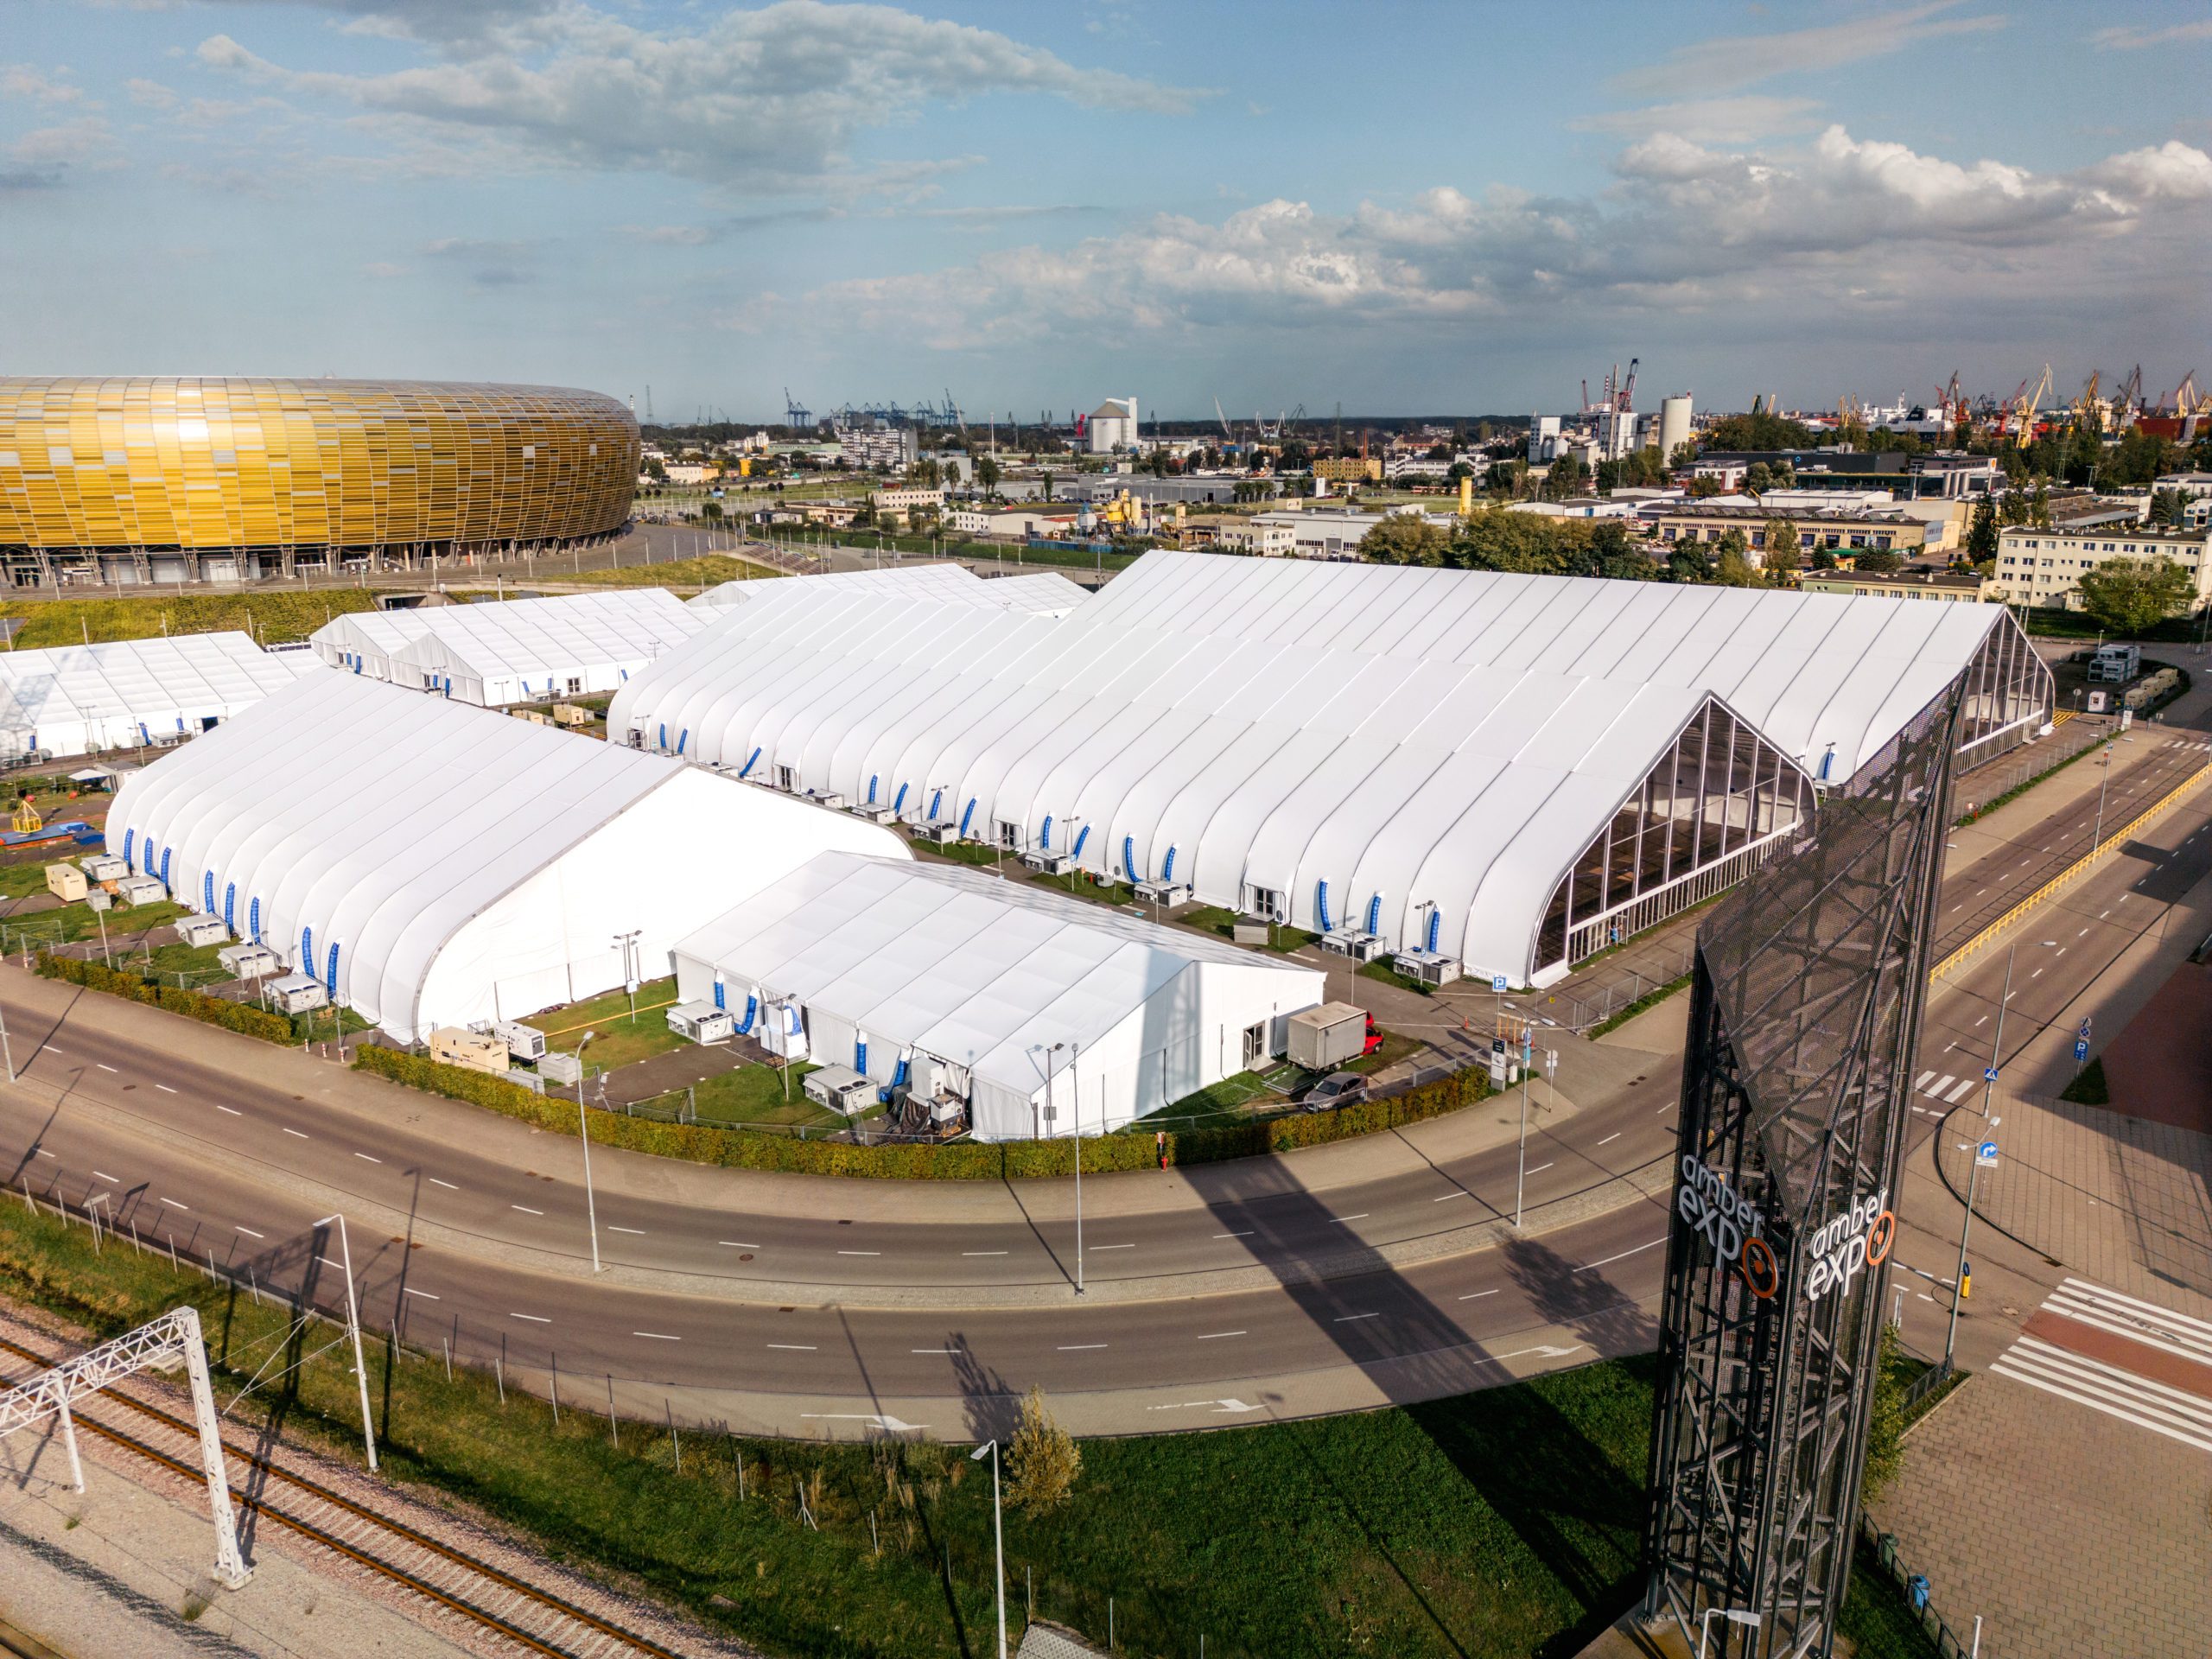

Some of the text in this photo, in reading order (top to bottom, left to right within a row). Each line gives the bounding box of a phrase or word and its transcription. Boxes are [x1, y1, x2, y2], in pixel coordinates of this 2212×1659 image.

[1496, 977, 1503, 988] P
[1682, 1155, 1764, 1237] amber
[1809, 1188, 1888, 1260] amber
[1679, 1185, 1779, 1299] expo
[1806, 1211, 1895, 1301] expo
